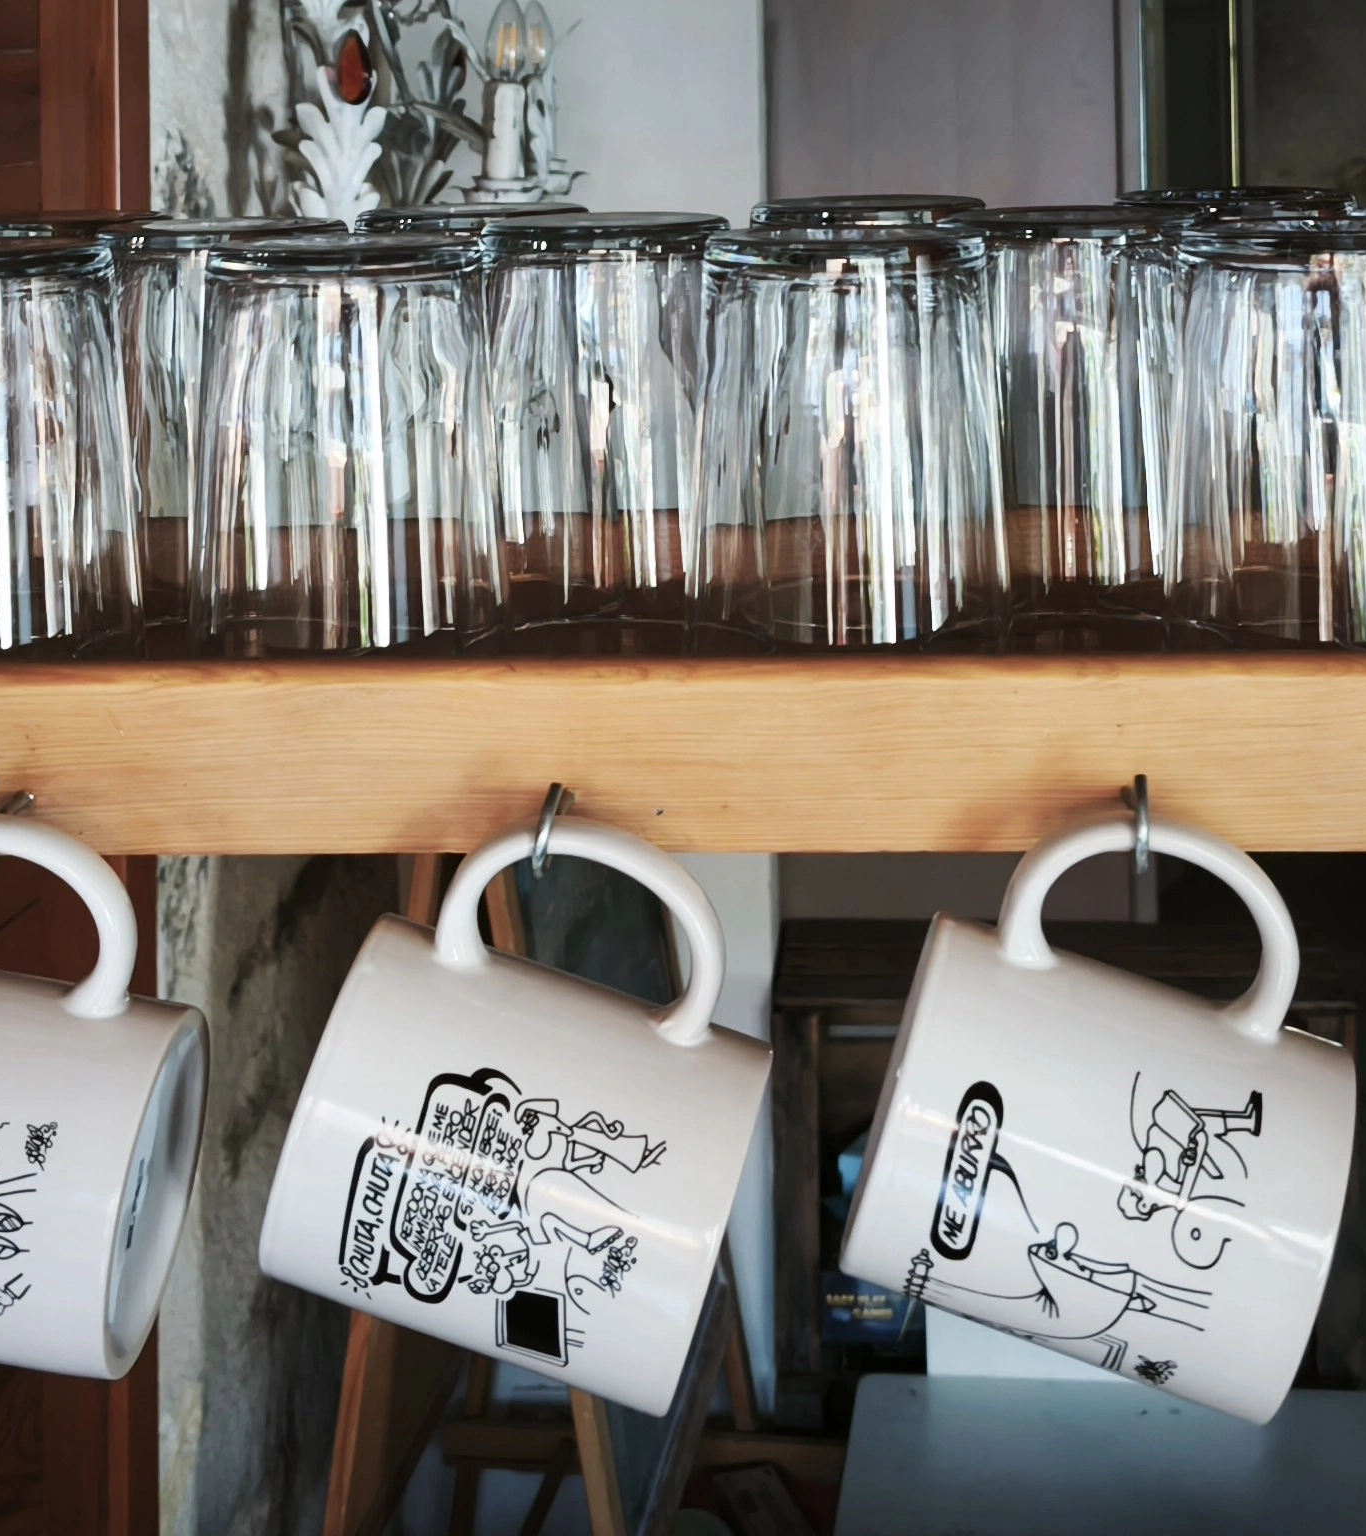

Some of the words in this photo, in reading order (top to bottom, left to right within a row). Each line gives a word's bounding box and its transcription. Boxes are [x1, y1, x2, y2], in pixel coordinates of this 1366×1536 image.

[400, 1169, 431, 1243] PERDONA
[433, 1103, 448, 1130] ME
[492, 1128, 509, 1164] QUE
[952, 1105, 991, 1207] ABURRO
[340, 1217, 384, 1288] ¡CHUTA,
[362, 1133, 408, 1216] CHUTA!
[943, 1205, 966, 1244] ME
[425, 1278, 441, 1292] LA
